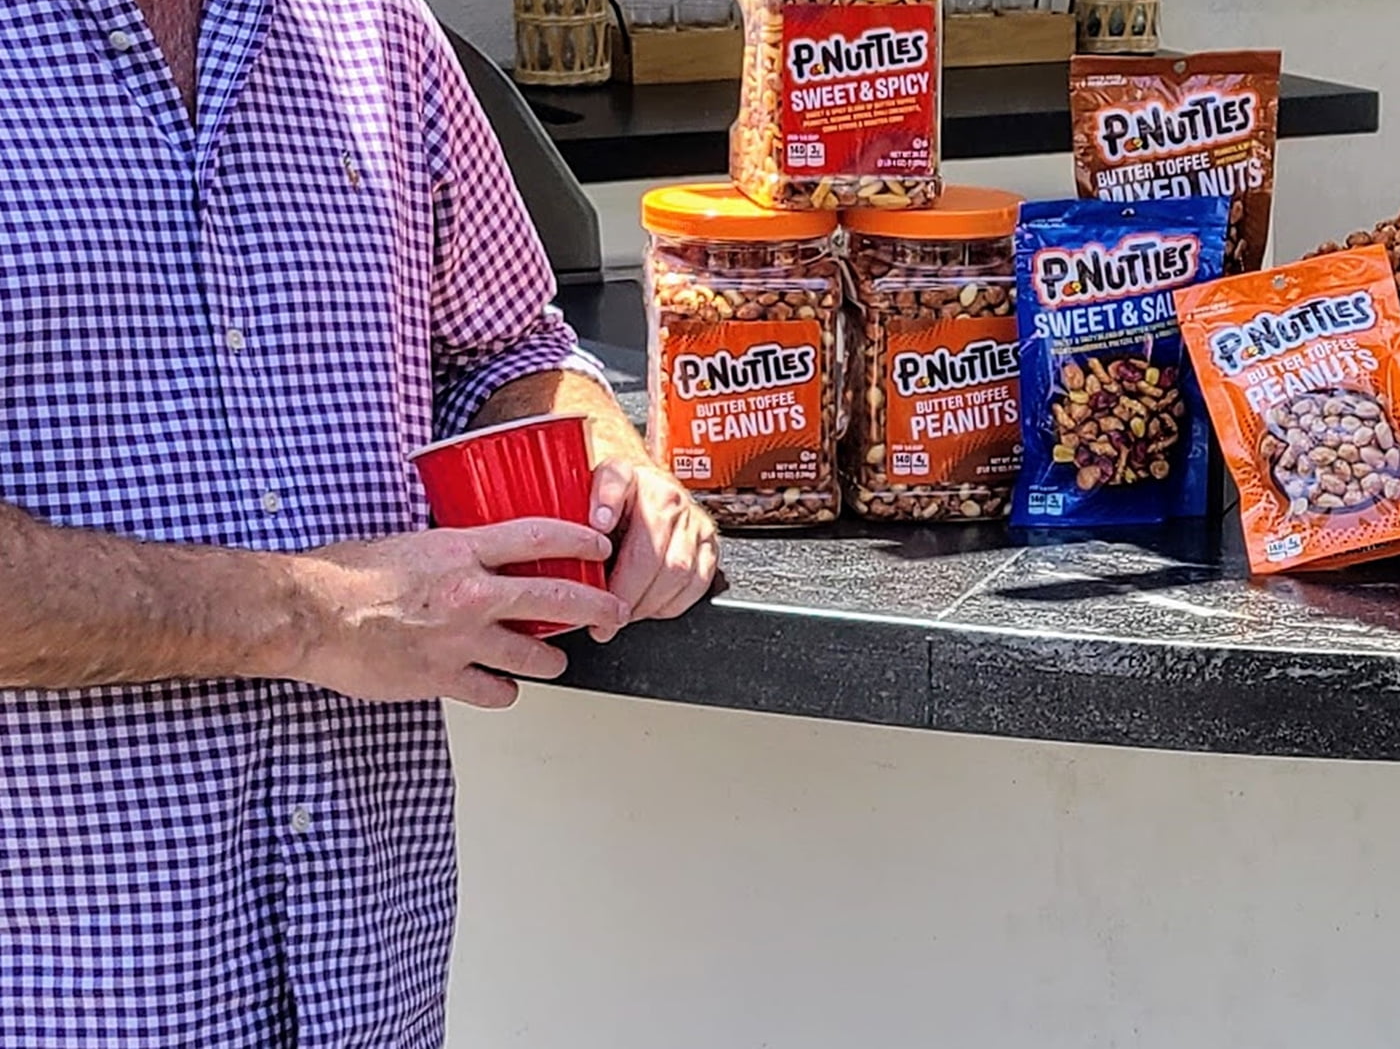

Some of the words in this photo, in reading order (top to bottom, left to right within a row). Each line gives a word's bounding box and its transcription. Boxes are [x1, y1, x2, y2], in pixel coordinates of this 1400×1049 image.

[791, 82, 858, 111] SWEET
[860, 81, 874, 101] &
[875, 72, 929, 99] SPICY
[1096, 163, 1154, 187] BUTTER
[1155, 153, 1211, 176] TOFFEE
[1197, 157, 1263, 198] NUTS
[1034, 303, 1117, 338] SWEET
[1121, 301, 1139, 327] &
[1141, 292, 1177, 322] SAL
[1246, 349, 1379, 413] PEANUTS
[1248, 352, 1305, 385] BUTTER
[1305, 338, 1359, 363] TOFFEE
[696, 400, 746, 417] BUTTER
[748, 391, 795, 410] TOFFEE
[911, 399, 1018, 440] PEANUTS
[916, 395, 963, 413] BUTTER
[965, 386, 1009, 406] TOFFEE
[691, 405, 806, 445] PEANUTS
